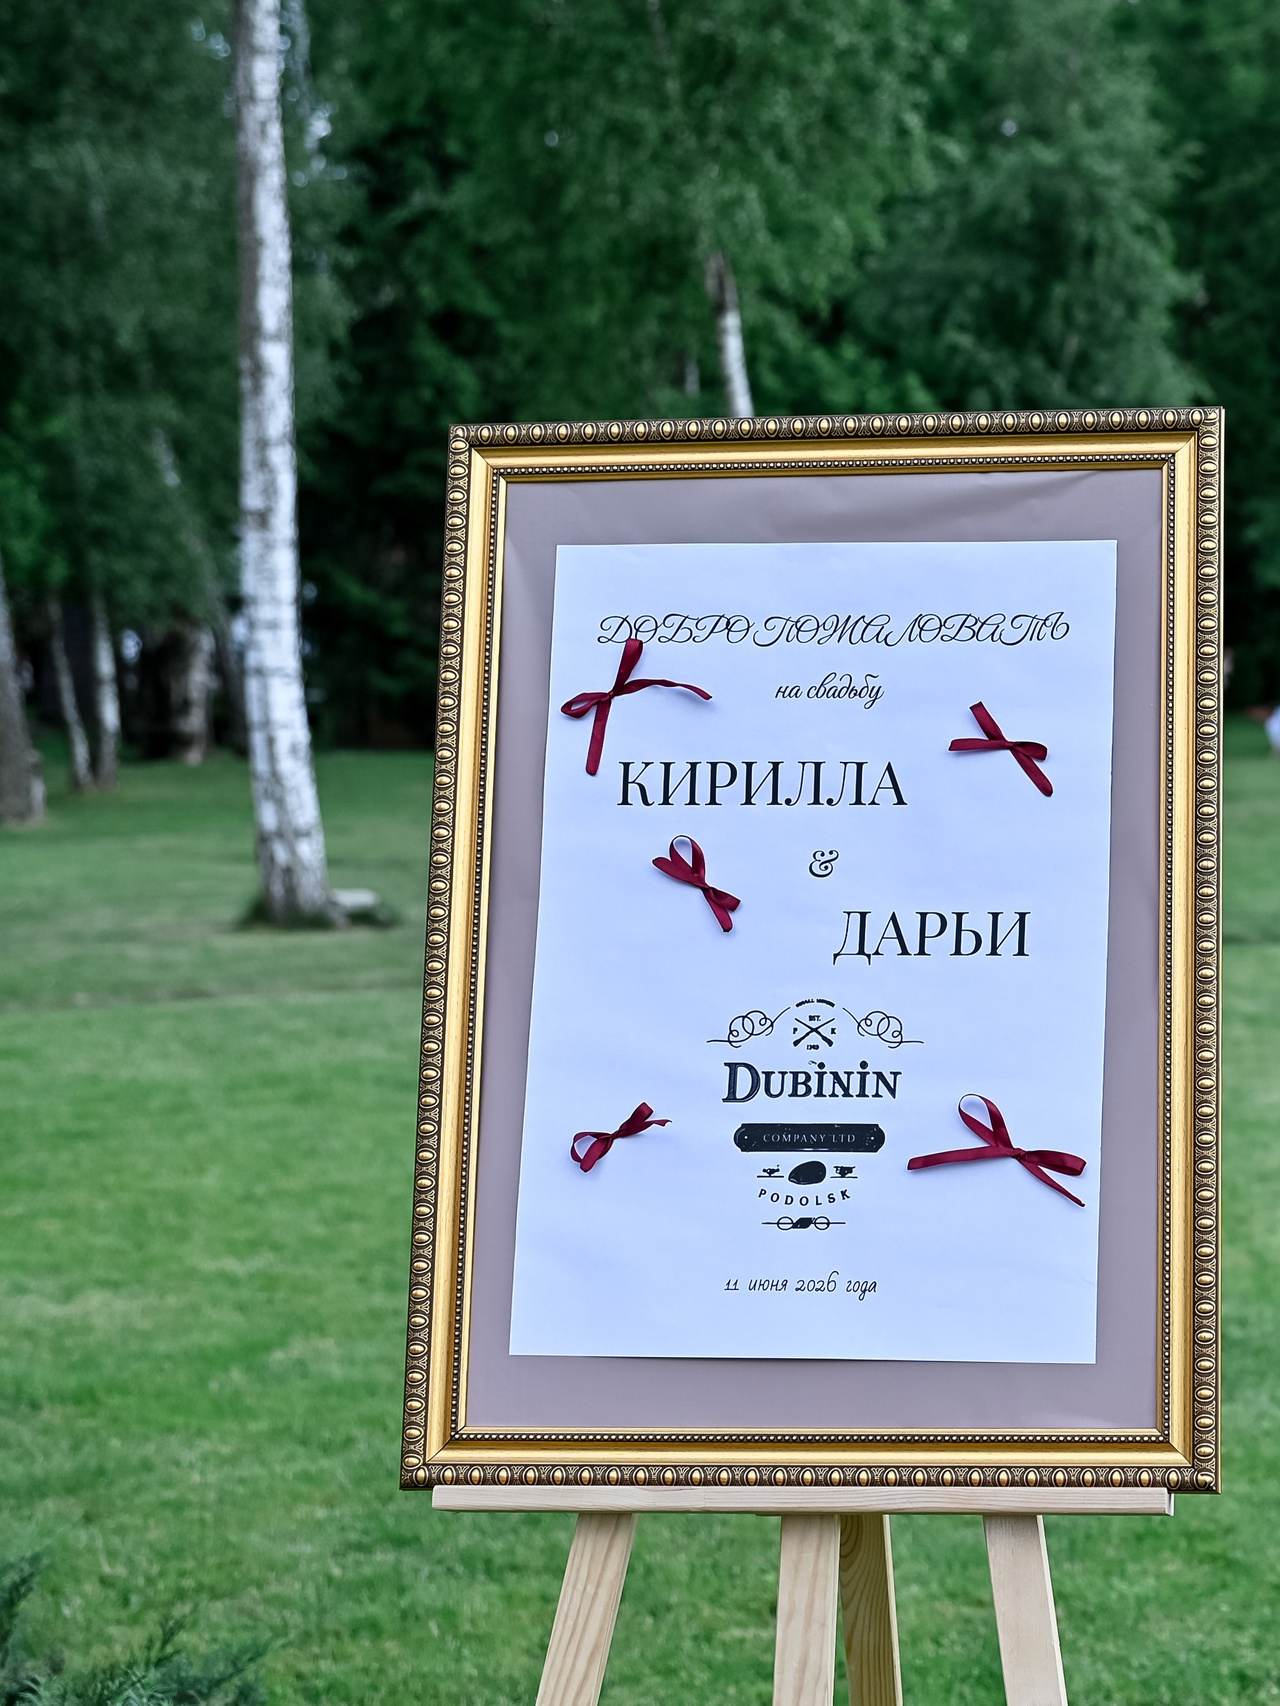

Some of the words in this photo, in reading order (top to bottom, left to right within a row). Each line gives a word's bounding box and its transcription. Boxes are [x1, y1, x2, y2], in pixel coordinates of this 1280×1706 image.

[596, 613, 753, 645] ДОБРО
[753, 611, 1071, 648] ПОЖАЛОВАТЬ
[774, 685, 803, 700] на
[806, 671, 885, 710] свадьбу
[616, 760, 908, 807] КИРИЛЛА
[808, 849, 840, 879] &
[832, 910, 1031, 967] ДАРЬИ
[762, 1133, 827, 1144] COMPANY
[831, 1133, 857, 1144] LTD
[757, 1188, 851, 1207] PODOLSK
[723, 1278, 740, 1291] 11
[748, 1278, 789, 1292] июня
[794, 1270, 840, 1293] 2026
[845, 1280, 877, 1302] года
